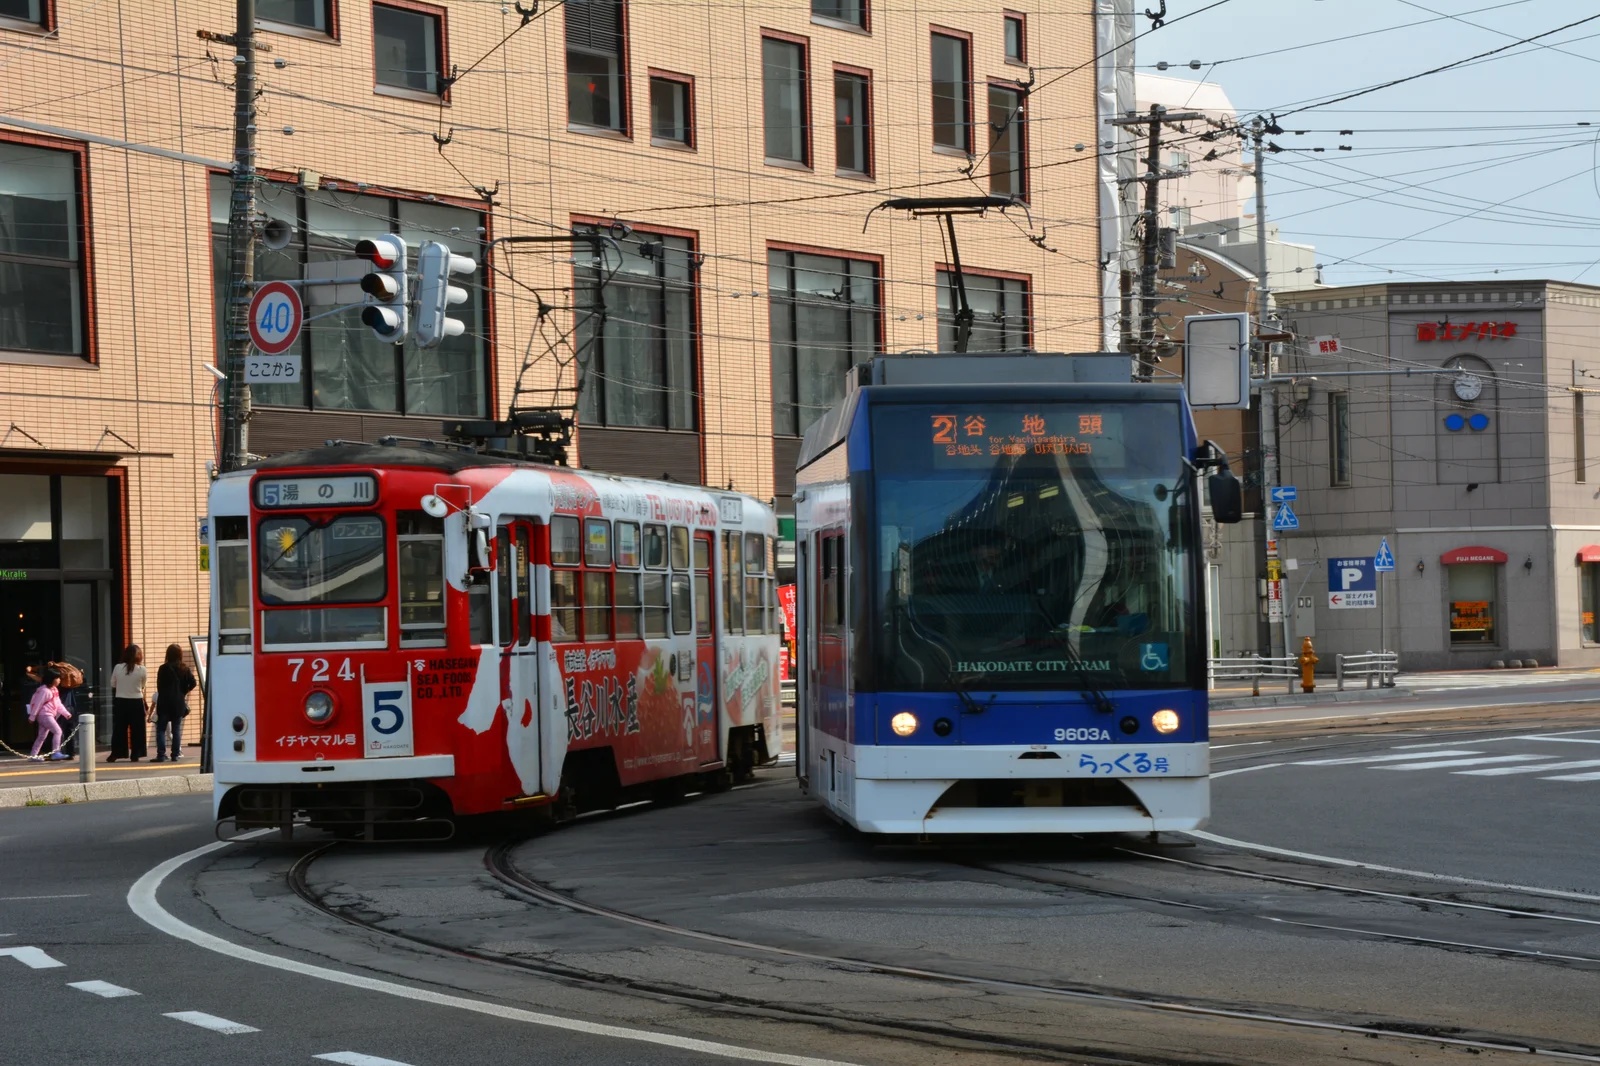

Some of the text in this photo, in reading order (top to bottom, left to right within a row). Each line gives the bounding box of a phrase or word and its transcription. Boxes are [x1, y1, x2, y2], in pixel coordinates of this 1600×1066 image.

[260, 302, 290, 333] 40
[1416, 322, 1518, 341] 富士メガネ
[1319, 340, 1338, 353] 解除
[249, 362, 295, 377] ここから
[932, 417, 952, 443] 2
[946, 444, 982, 456] 谷地头
[265, 487, 278, 505] 5
[335, 524, 380, 537] ワンマン
[3, 569, 27, 578] Kiralis
[1341, 568, 1362, 590] P
[287, 657, 356, 682] 724
[957, 660, 1111, 672] HAKODATE CITY TRAM
[417, 671, 472, 686] SEA FOODS
[371, 690, 404, 734] 5
[563, 672, 641, 746] 長谷川水産
[275, 733, 357, 747] イチヤママル号
[1054, 728, 1111, 741] 9603A
[1079, 752, 1170, 774] らっくる号
